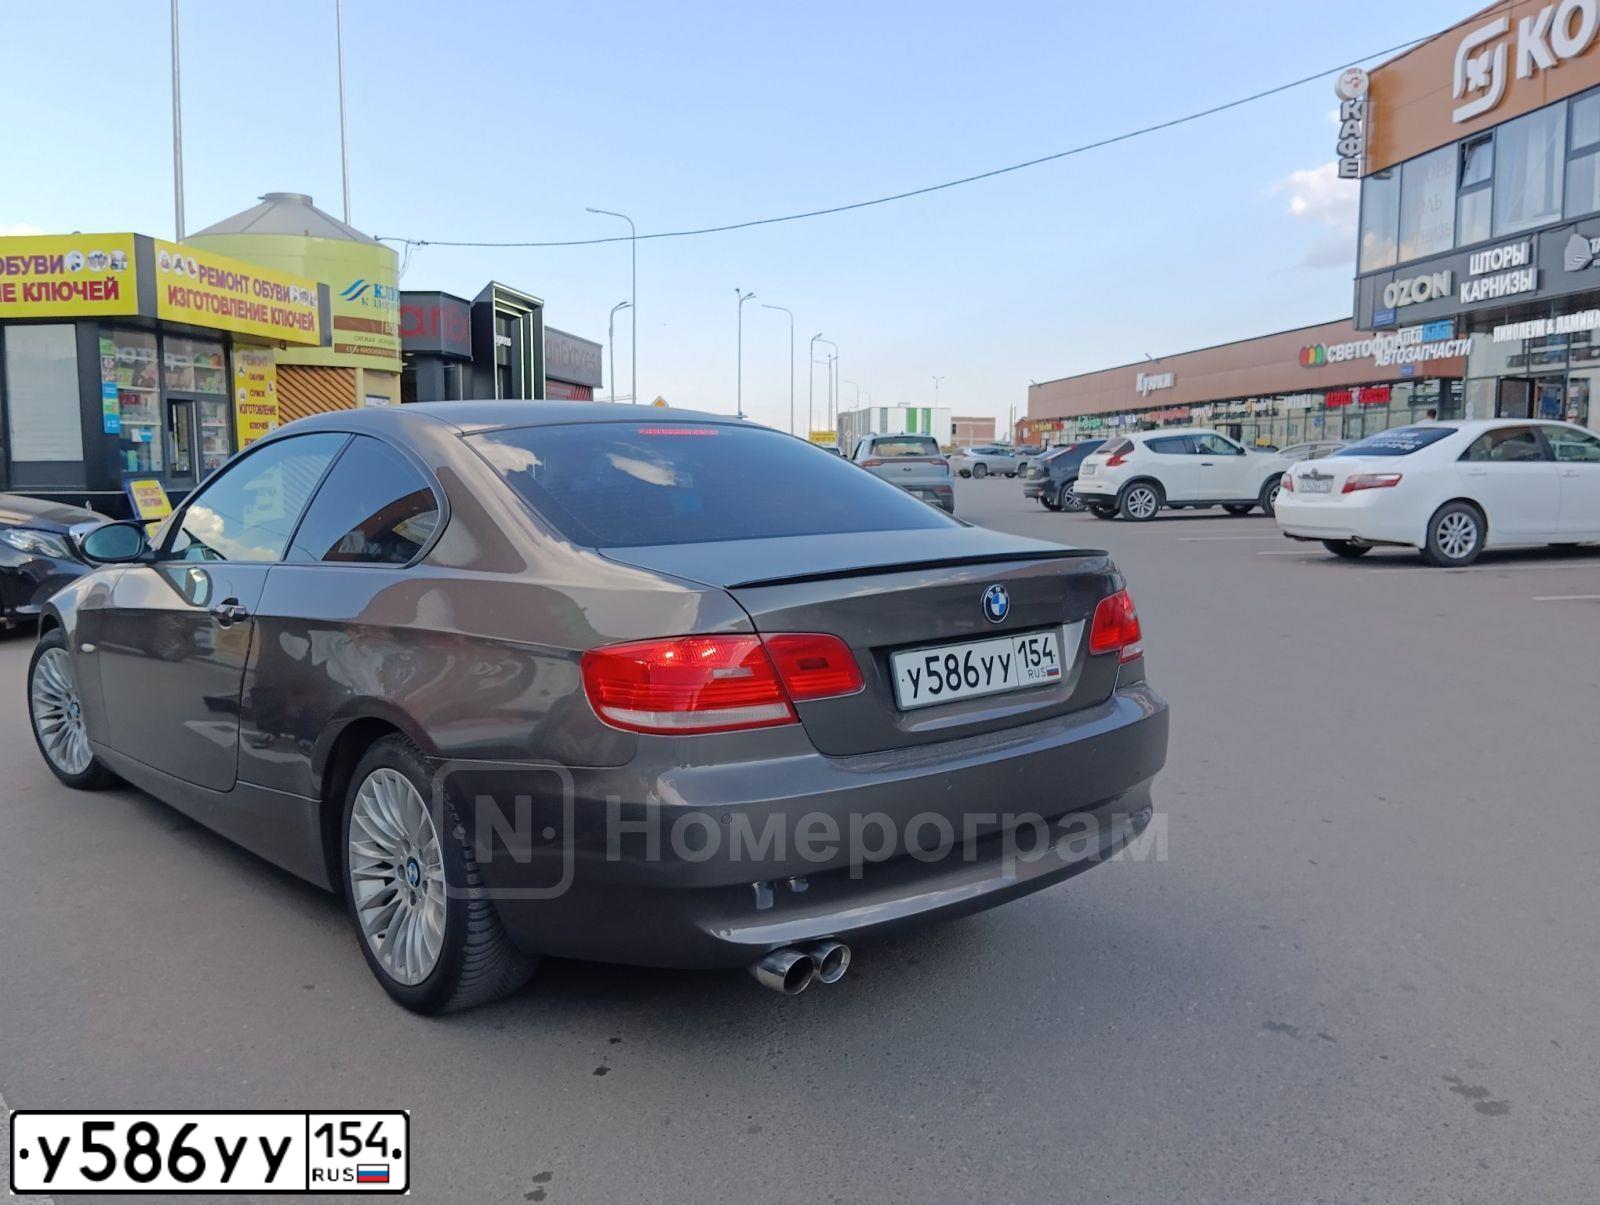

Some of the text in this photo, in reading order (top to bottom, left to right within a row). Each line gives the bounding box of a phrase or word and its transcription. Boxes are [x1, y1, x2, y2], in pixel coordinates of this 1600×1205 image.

[1337, 101, 1362, 179] КАФЕ
[0, 254, 64, 276] БУВИ
[1469, 242, 1530, 275] ШТОРЫ
[0, 277, 119, 303] Е КЛЮЧЕЙ
[198, 264, 291, 304] РЕМОНТ ОБУВИ
[1384, 270, 1452, 309] OZON
[1460, 267, 1537, 304] КАРНИЗЫ
[168, 285, 314, 333] ИЗГОТОВЛЕНИЕ КЛЮЧЕЙ
[1493, 318, 1546, 343] ЛИНОЛЕУМ
[1017, 637, 1054, 669] 154
[1027, 666, 1047, 680] RUS
